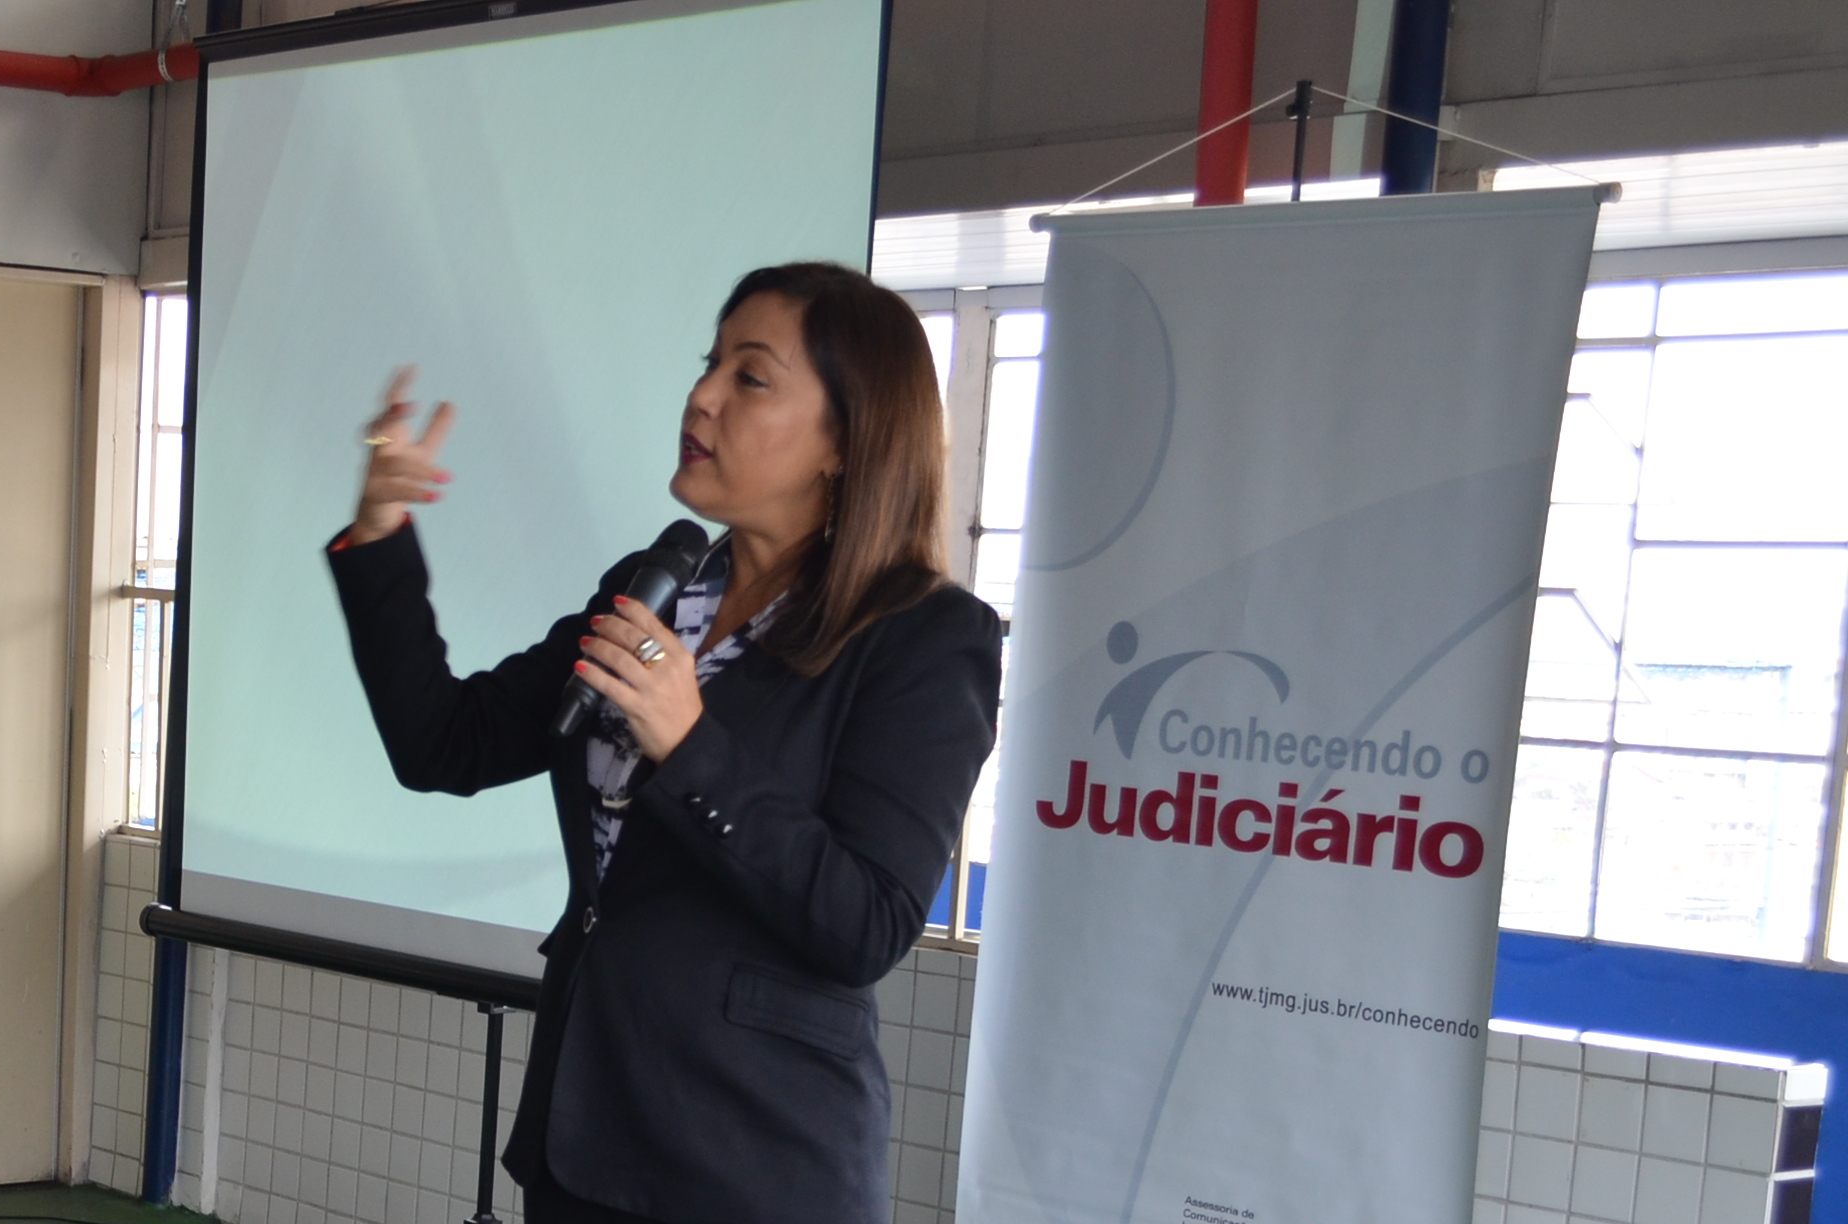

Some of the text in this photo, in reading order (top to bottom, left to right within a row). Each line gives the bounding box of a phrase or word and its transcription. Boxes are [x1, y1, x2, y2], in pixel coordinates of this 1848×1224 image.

[1158, 708, 1490, 784] Conhecendo o
[1035, 759, 1485, 879] Judiciário
[1211, 981, 1480, 1040] www.tjmg.jus.br/conhecendo
[1184, 1196, 1255, 1220] Assessoria de
